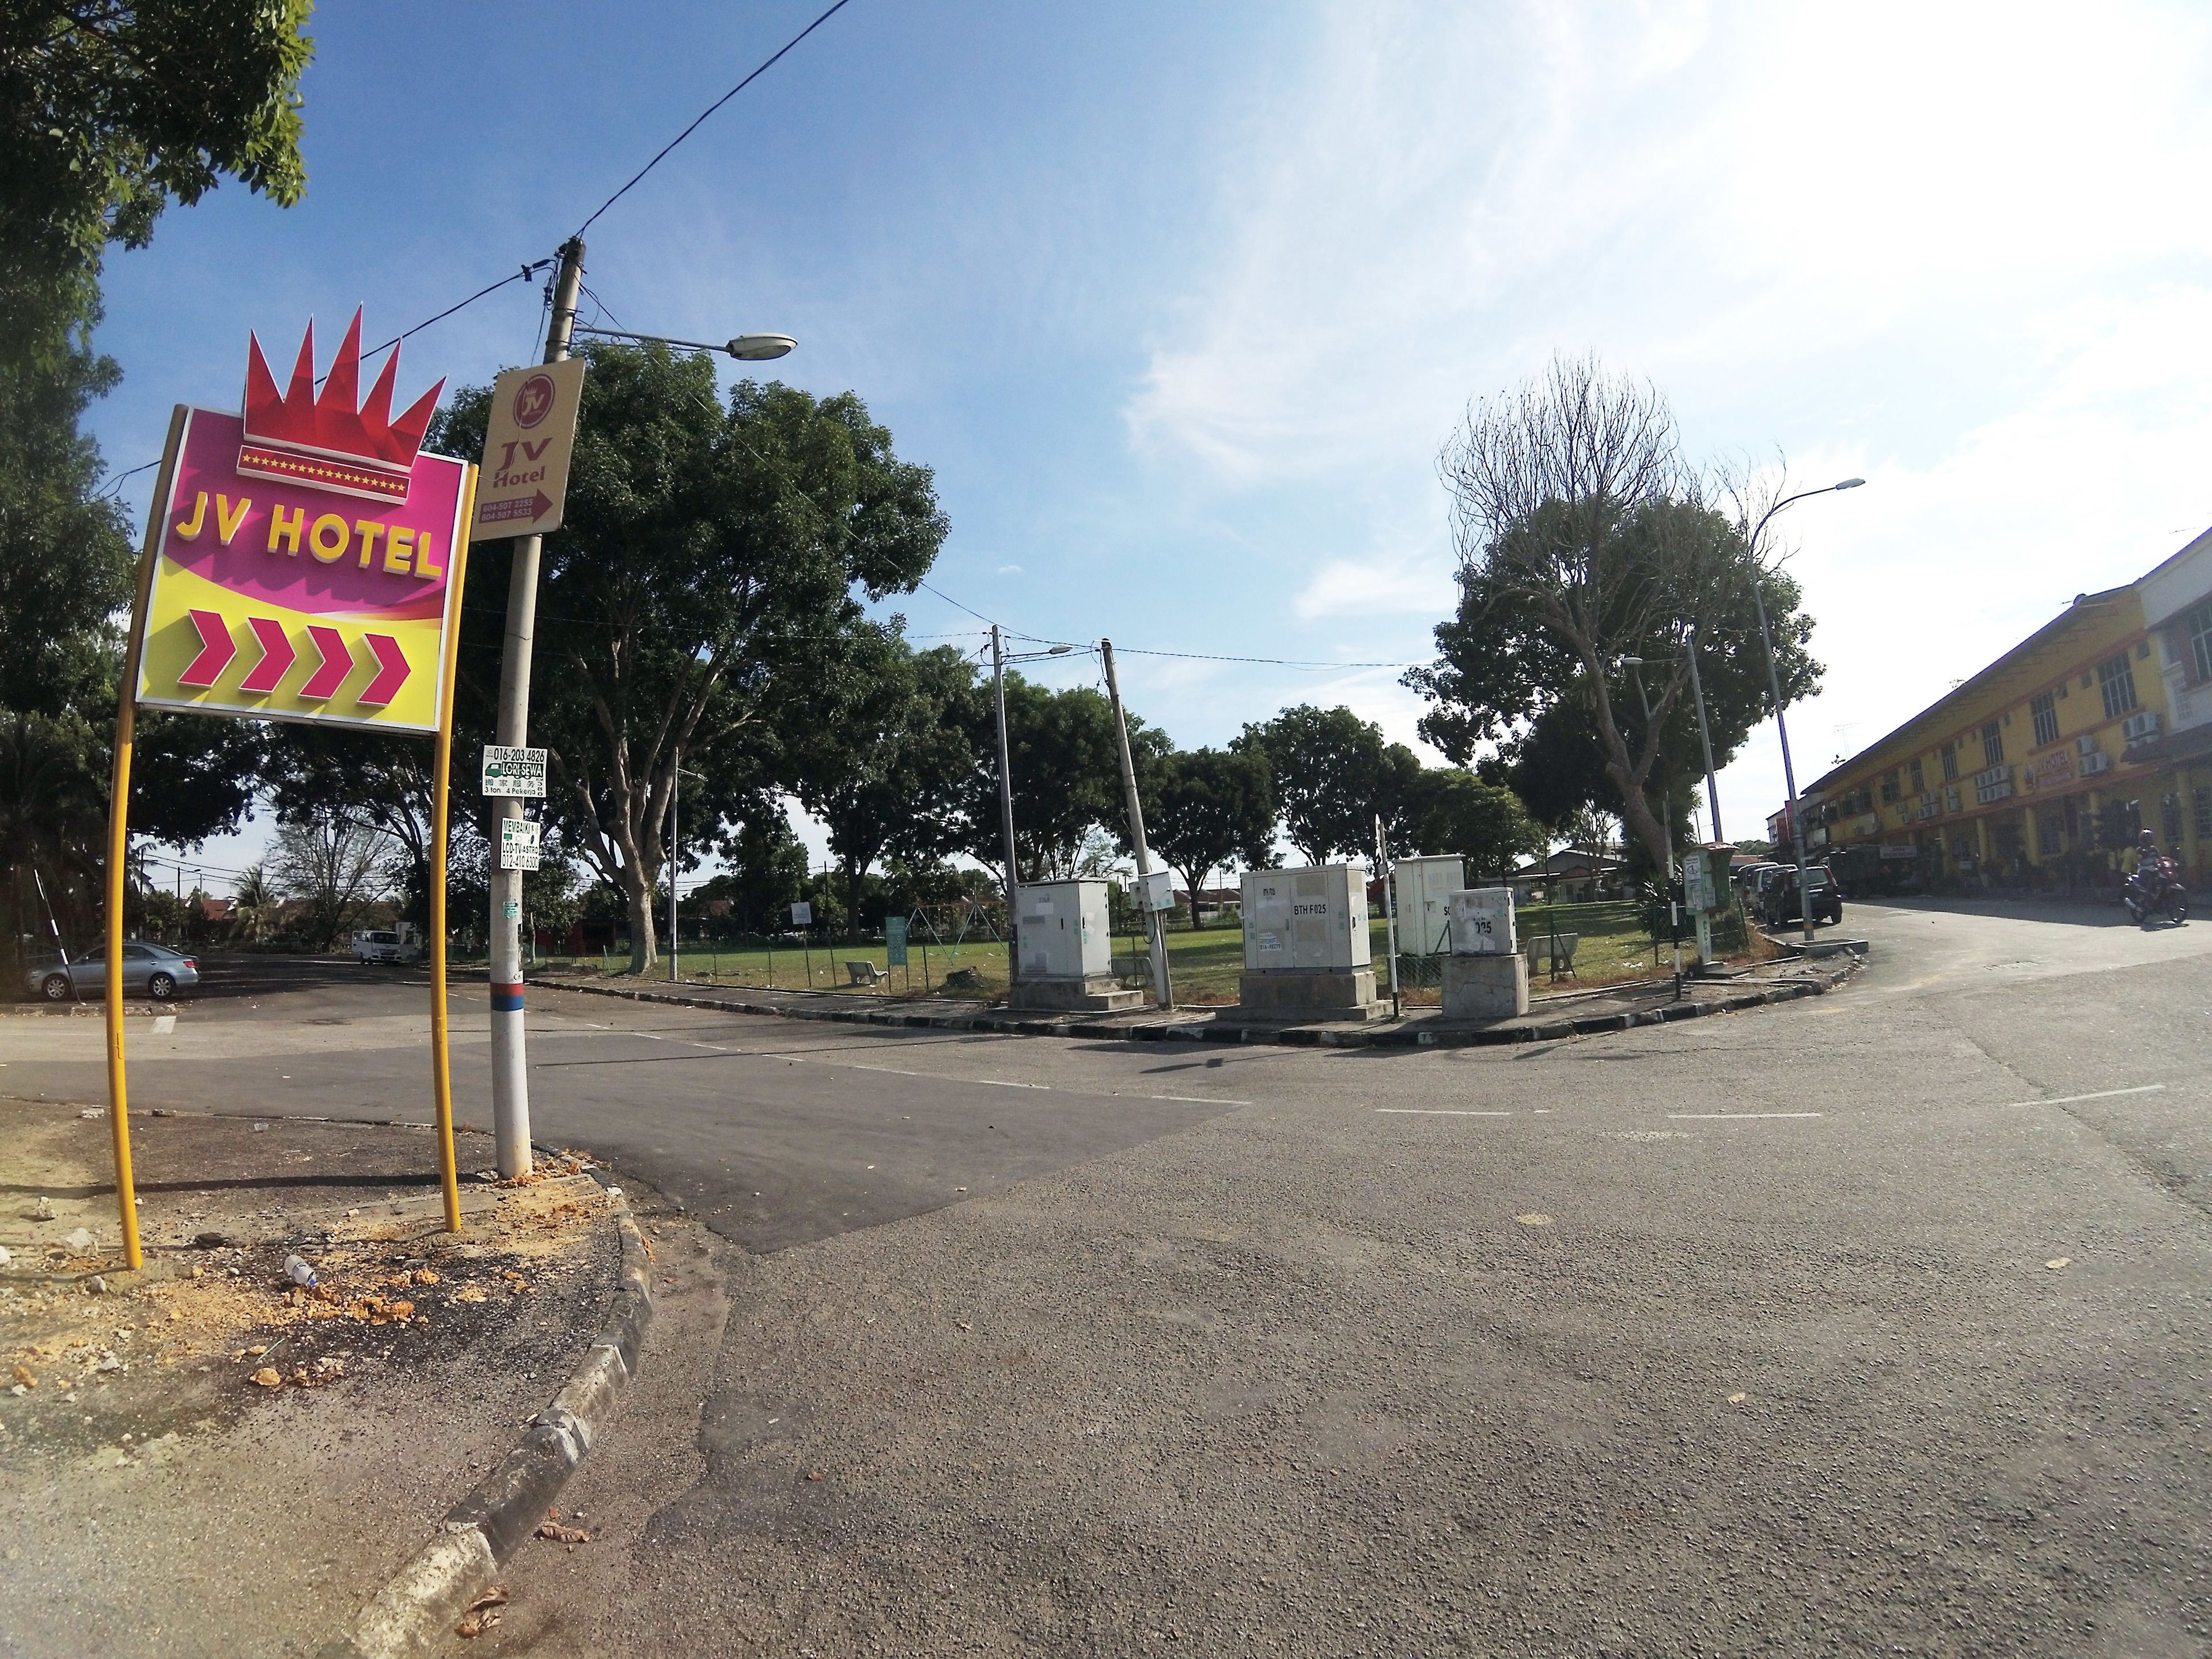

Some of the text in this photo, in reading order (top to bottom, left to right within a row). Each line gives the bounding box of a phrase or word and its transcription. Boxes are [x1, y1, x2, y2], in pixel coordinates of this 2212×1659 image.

[496, 437, 553, 472] JV
[493, 465, 546, 488] Hotel
[482, 498, 533, 512] 604-507 2255
[481, 507, 532, 521] 604-507 5533
[176, 491, 442, 580] JV HOTEL
[494, 748, 544, 763] 016-203 4826
[502, 762, 543, 776] LORI SEWA
[503, 820, 530, 834] MEMBAIKI
[502, 854, 525, 868] 012-410
[1294, 905, 1308, 915] BTH
